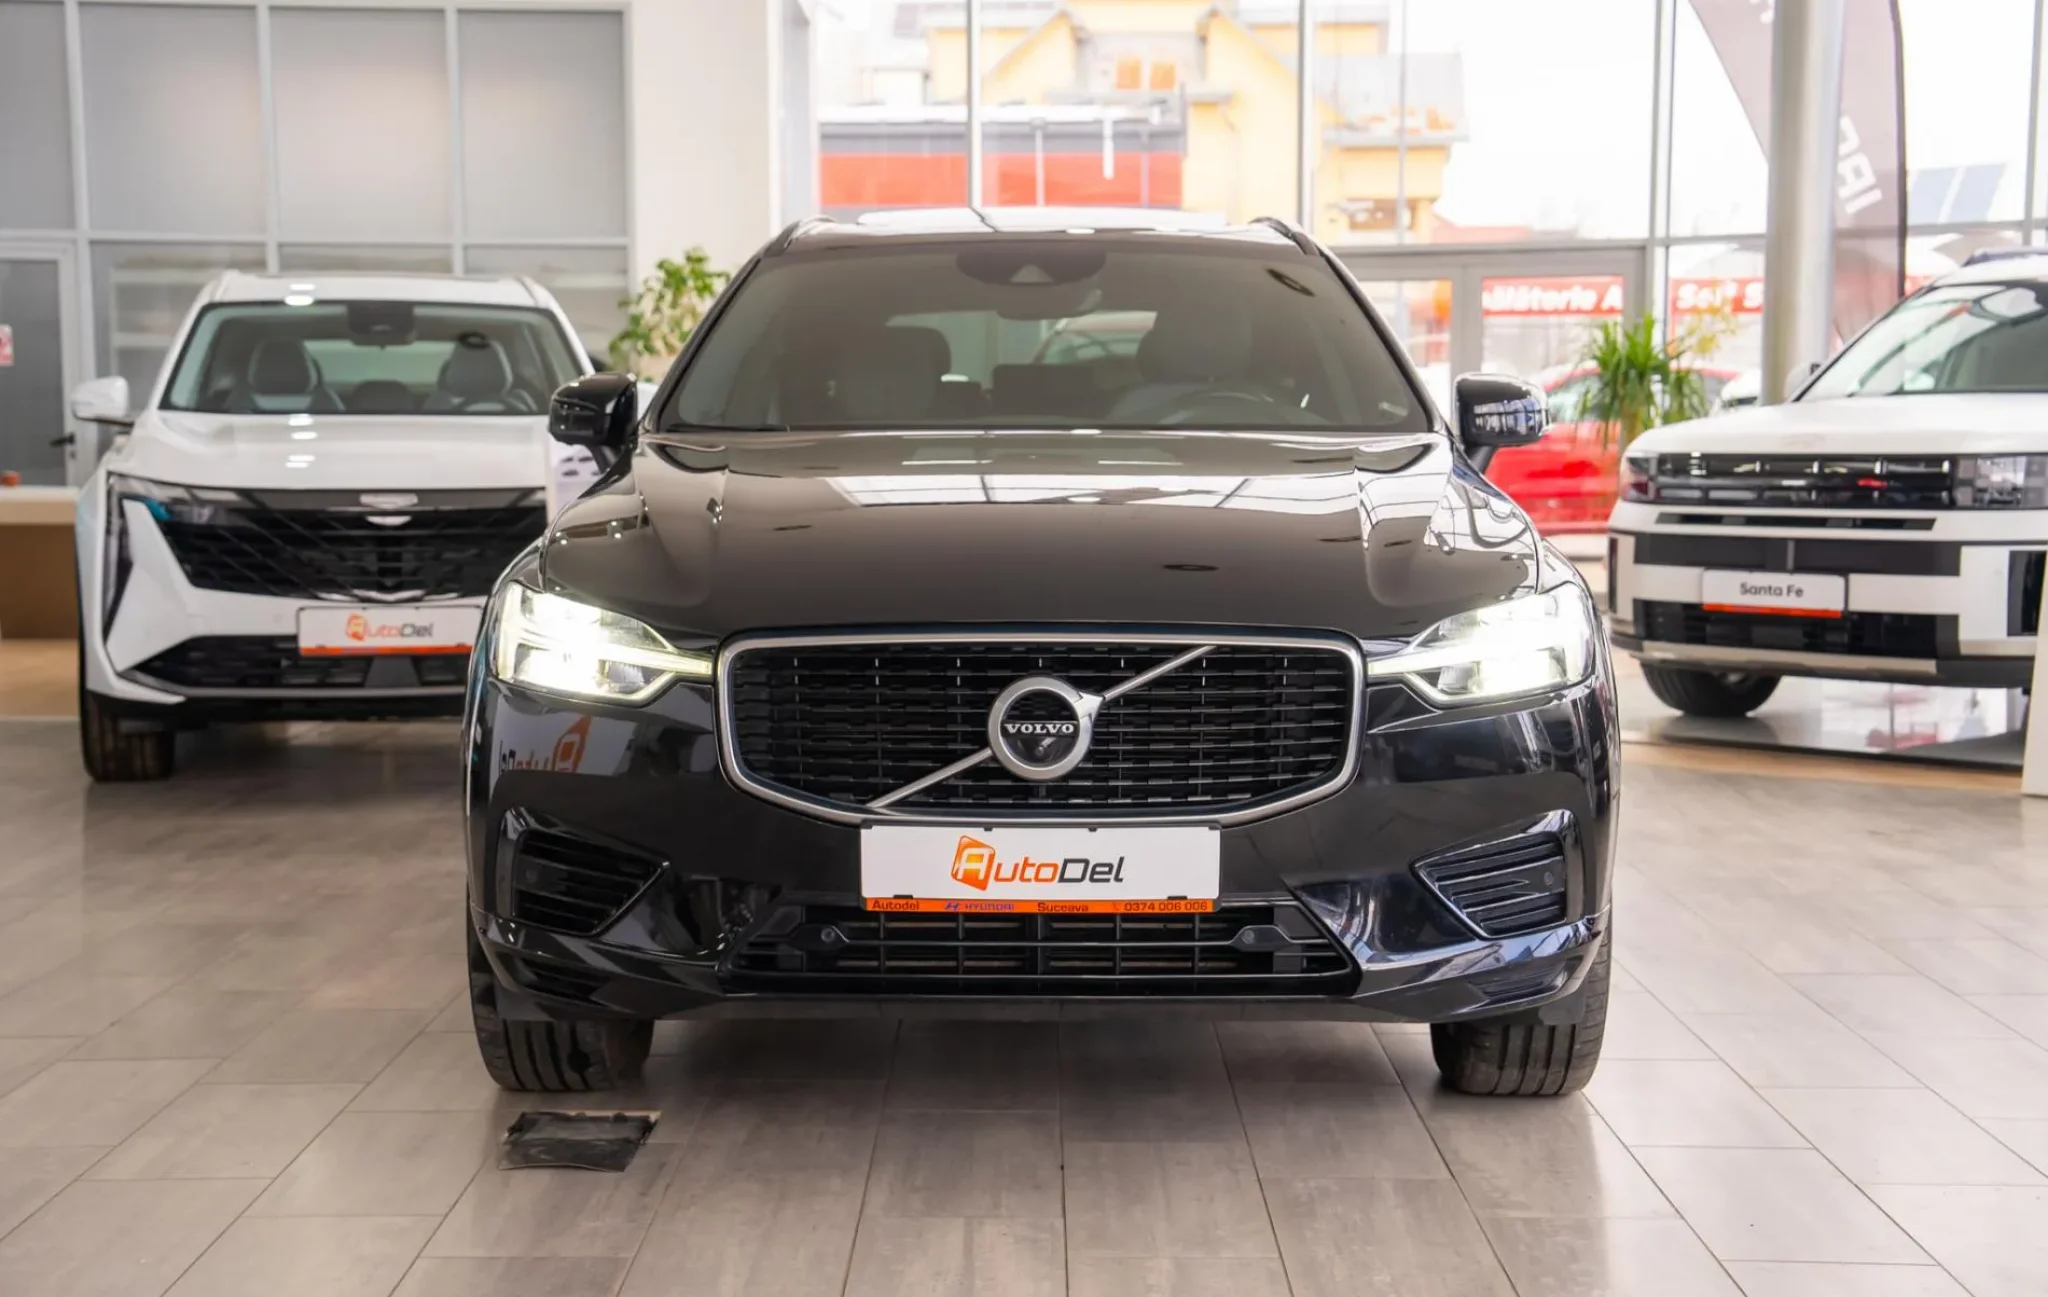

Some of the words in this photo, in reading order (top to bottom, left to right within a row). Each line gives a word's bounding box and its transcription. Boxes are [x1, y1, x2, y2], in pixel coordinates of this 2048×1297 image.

[1739, 581, 1783, 597] Santa
[1786, 584, 1805, 597] Fe
[346, 613, 434, 642] AutoDel
[1003, 723, 1075, 735] VOLVO
[951, 836, 1125, 890] AutoDel
[872, 900, 920, 911] Autodel
[1037, 902, 1089, 912] Suceava
[1124, 901, 1156, 912] 0374
[1158, 901, 1181, 912] 006
[1184, 901, 1208, 911] 006
